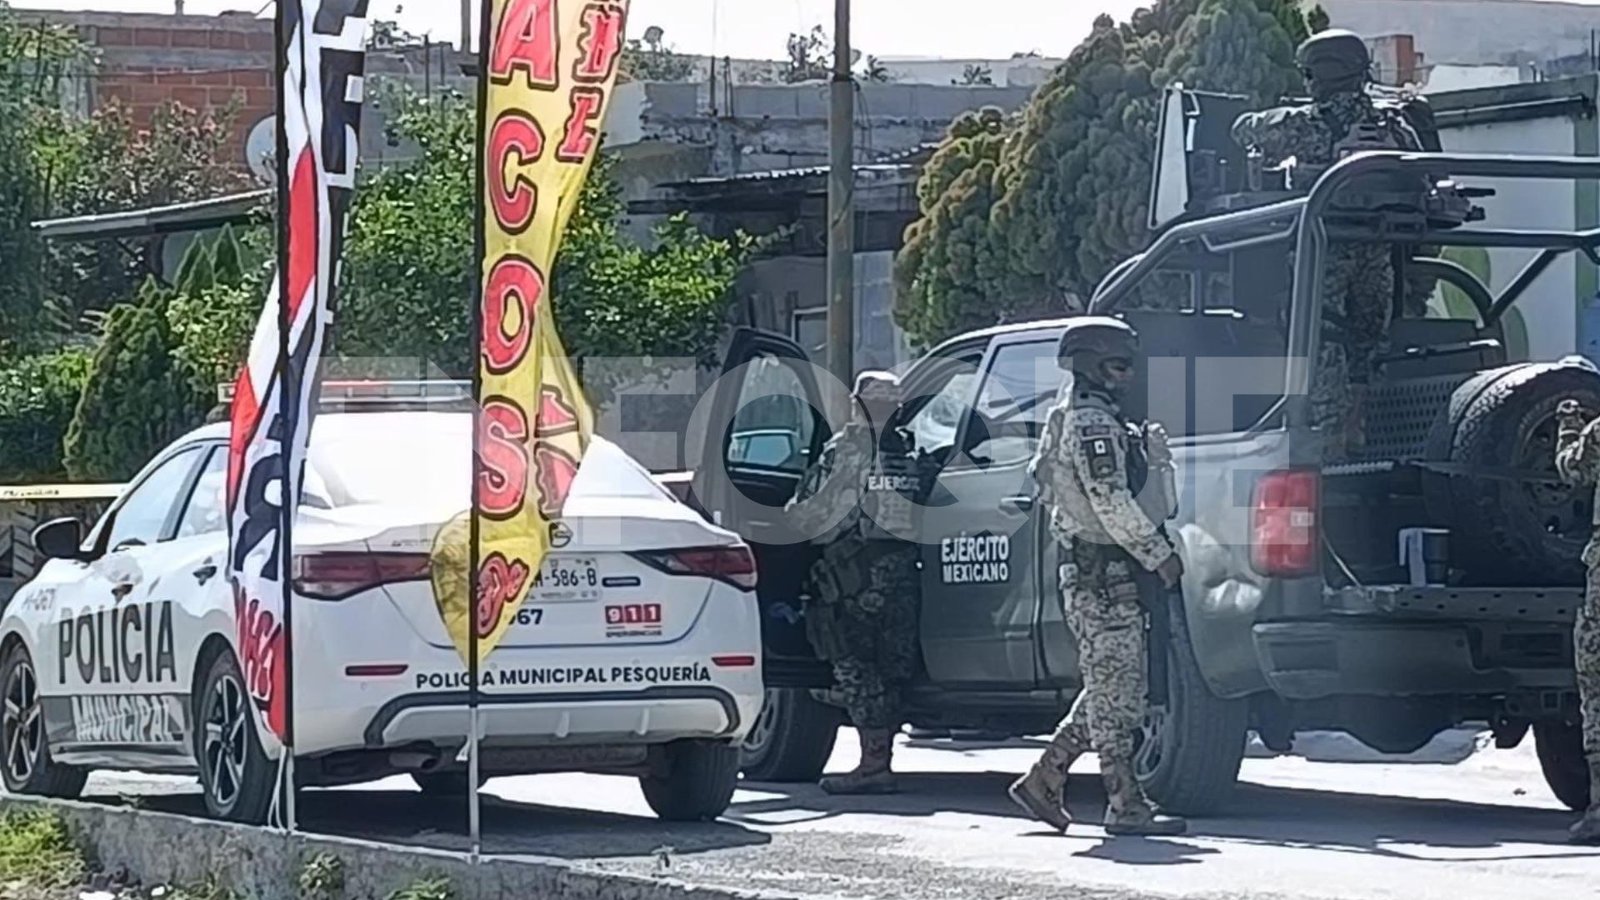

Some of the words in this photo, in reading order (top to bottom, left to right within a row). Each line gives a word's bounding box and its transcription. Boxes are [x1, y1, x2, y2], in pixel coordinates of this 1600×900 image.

[941, 531, 1010, 562] EJÉRCITO
[943, 563, 1009, 583] MEXICANO
[607, 605, 658, 622] 911
[416, 671, 495, 689] POLICA
[500, 667, 606, 685] MUNICIPAL
[611, 662, 711, 683] PESQUERÍA
